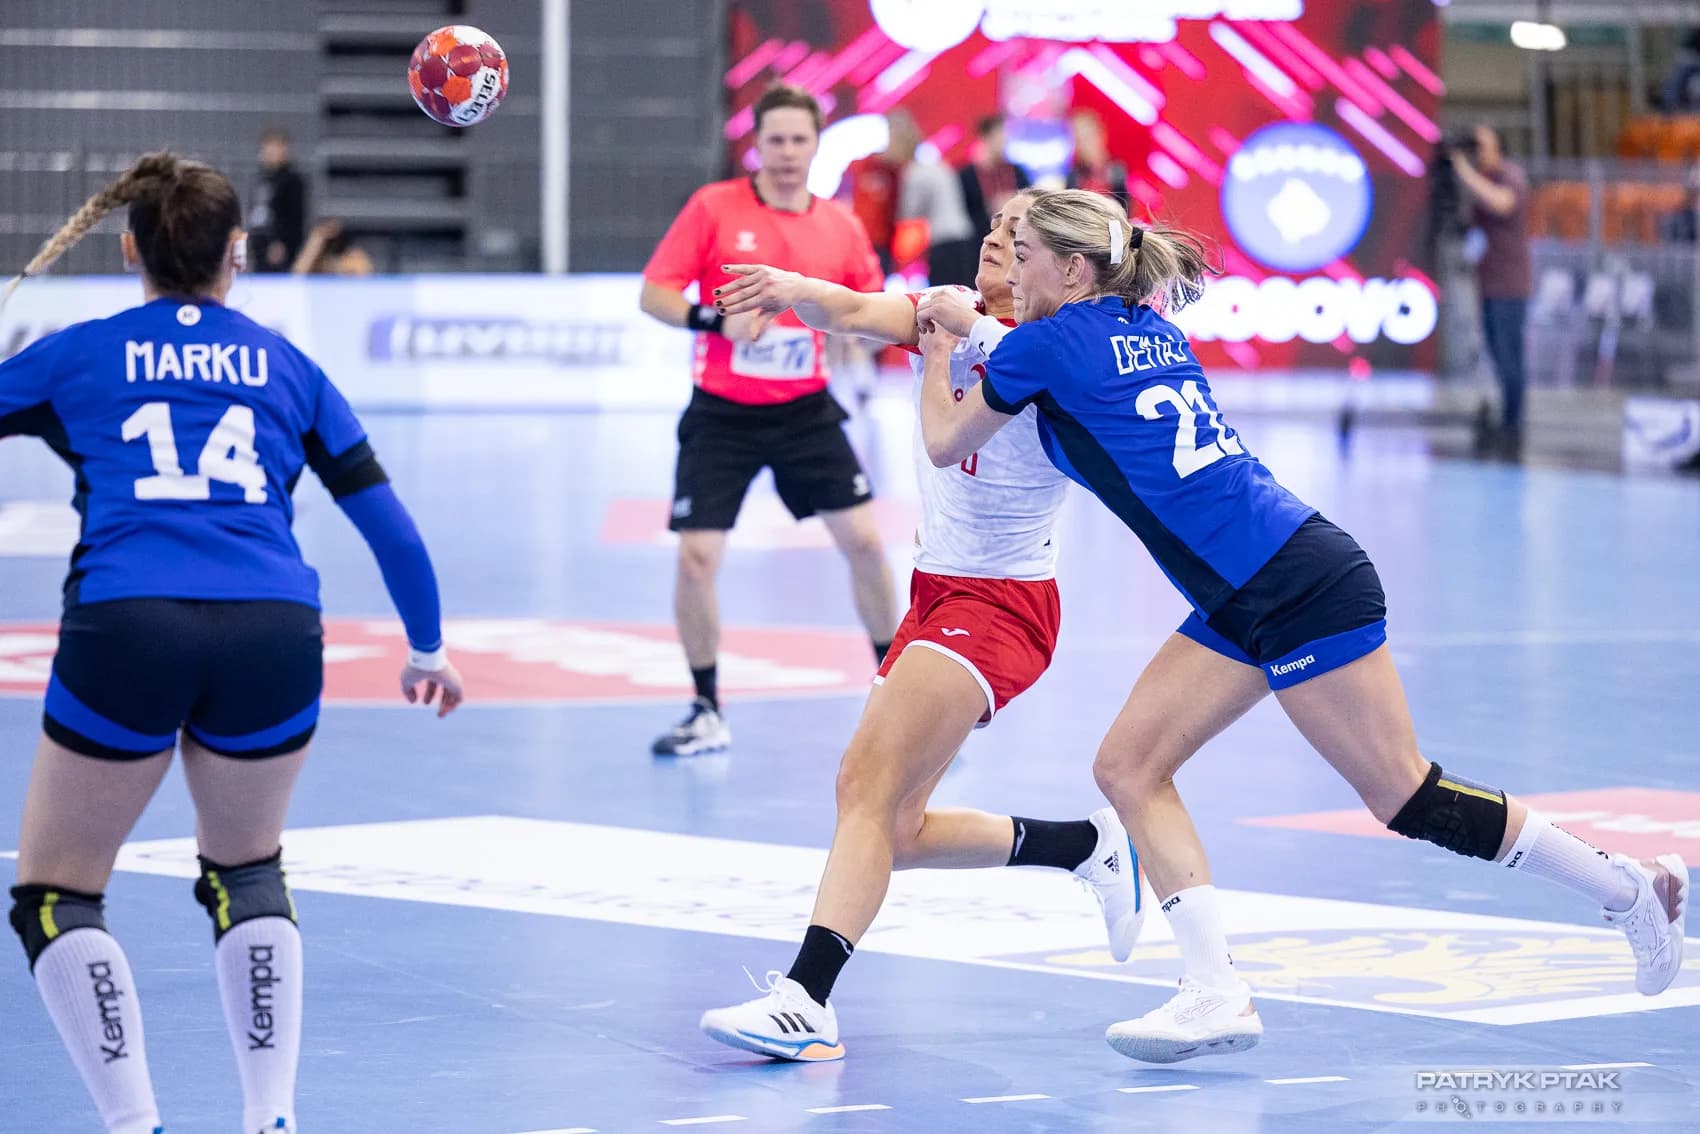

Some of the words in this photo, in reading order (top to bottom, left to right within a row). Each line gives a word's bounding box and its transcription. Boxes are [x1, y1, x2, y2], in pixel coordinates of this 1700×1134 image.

[456, 73, 496, 122] SELECT
[125, 340, 268, 386] MARKU
[1110, 335, 1188, 375] DEMAJ
[121, 402, 268, 504] 14
[1270, 654, 1316, 676] Kempa
[86, 960, 128, 1063] Kempa
[247, 945, 281, 1051] Kempa
